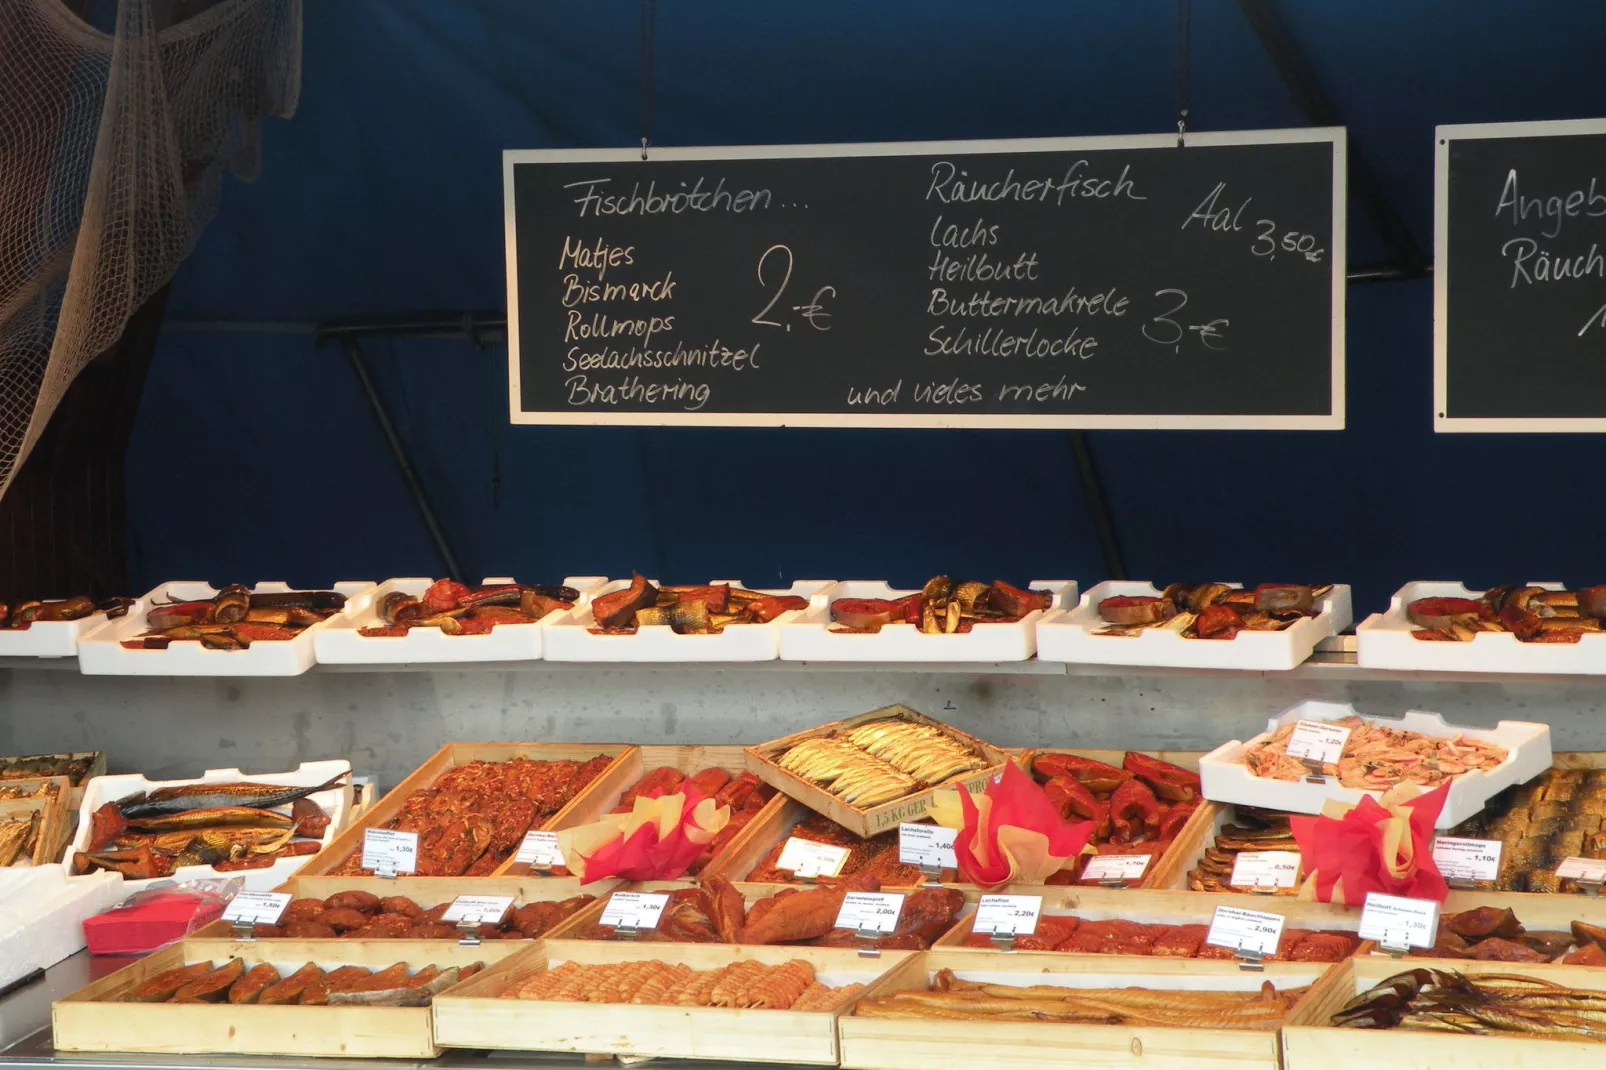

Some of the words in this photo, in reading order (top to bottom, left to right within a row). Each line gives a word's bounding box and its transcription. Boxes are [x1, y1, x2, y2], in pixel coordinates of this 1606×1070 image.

[926, 160, 1148, 206] Räucherfisch
[1181, 182, 1252, 231] Aal
[930, 215, 1000, 248] Lachs
[558, 236, 636, 281] Matjes
[928, 250, 1039, 281] Heilbutt
[1501, 237, 1604, 289] Räuch
[562, 271, 677, 308] Bismarck
[926, 287, 1130, 317] Buttermakrele
[564, 310, 676, 349] Rollmops
[924, 325, 1099, 360] Schillerlocke
[562, 339, 760, 372] Seelachsschnitzel
[564, 374, 711, 411] Brathering
[847, 378, 903, 406] und
[914, 377, 983, 404] vieles
[998, 374, 1086, 402] mehr
[890, 804, 906, 822] KG
[1274, 863, 1296, 871] 0,50€
[1474, 854, 1496, 862] 1,10€
[1013, 909, 1035, 917] 2,20€
[1404, 920, 1428, 930] 1,30€
[1254, 925, 1277, 935] 2,90€
